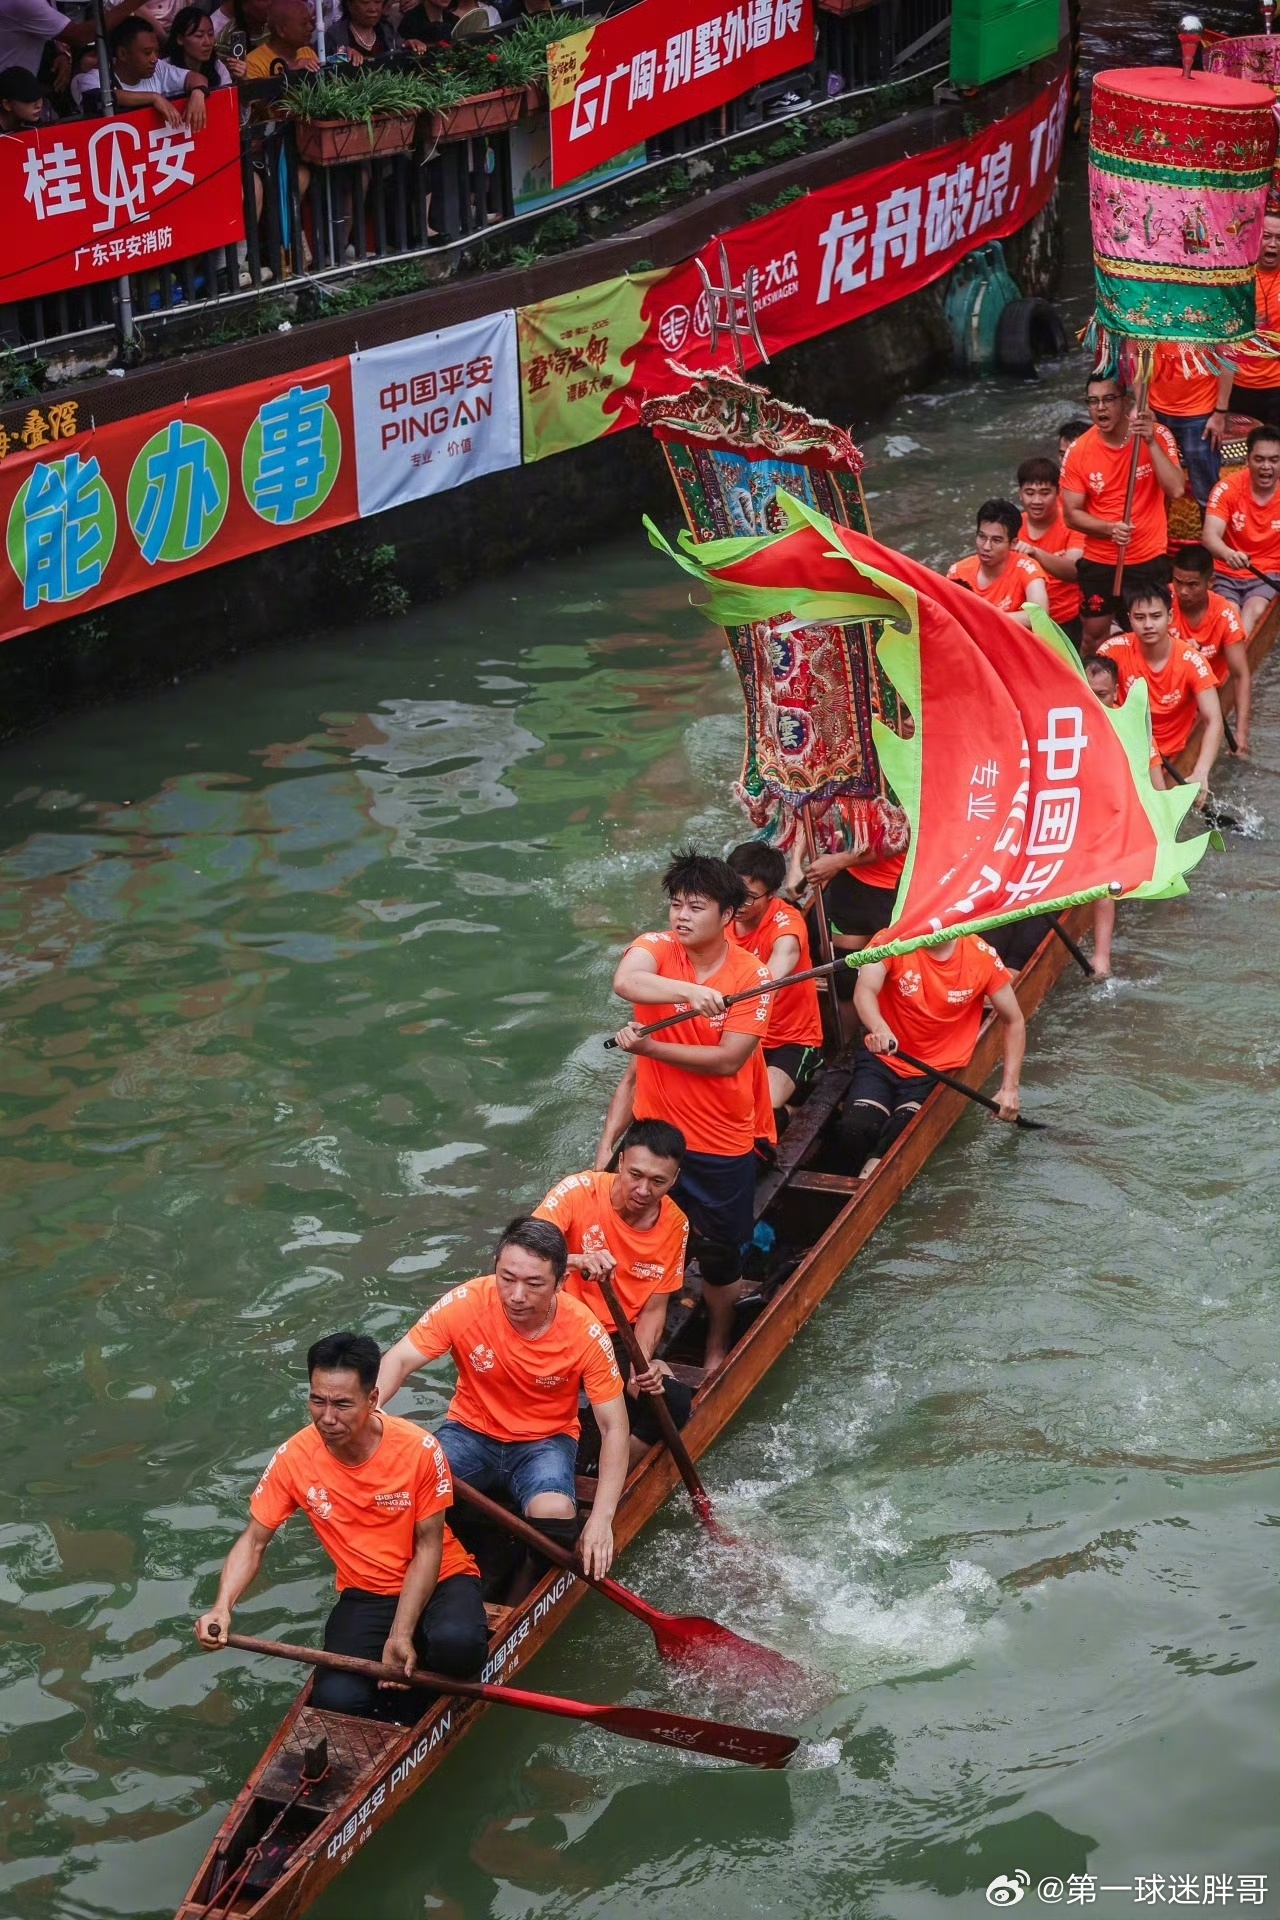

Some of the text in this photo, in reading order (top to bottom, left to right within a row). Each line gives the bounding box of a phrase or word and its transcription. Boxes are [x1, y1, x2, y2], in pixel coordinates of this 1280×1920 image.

[74, 227, 173, 271] 广东平安消防
[380, 355, 494, 413] 中国平安
[481, 1570, 579, 1684] 中国平安 PINGA
[327, 1782, 386, 1860] 中国平安
